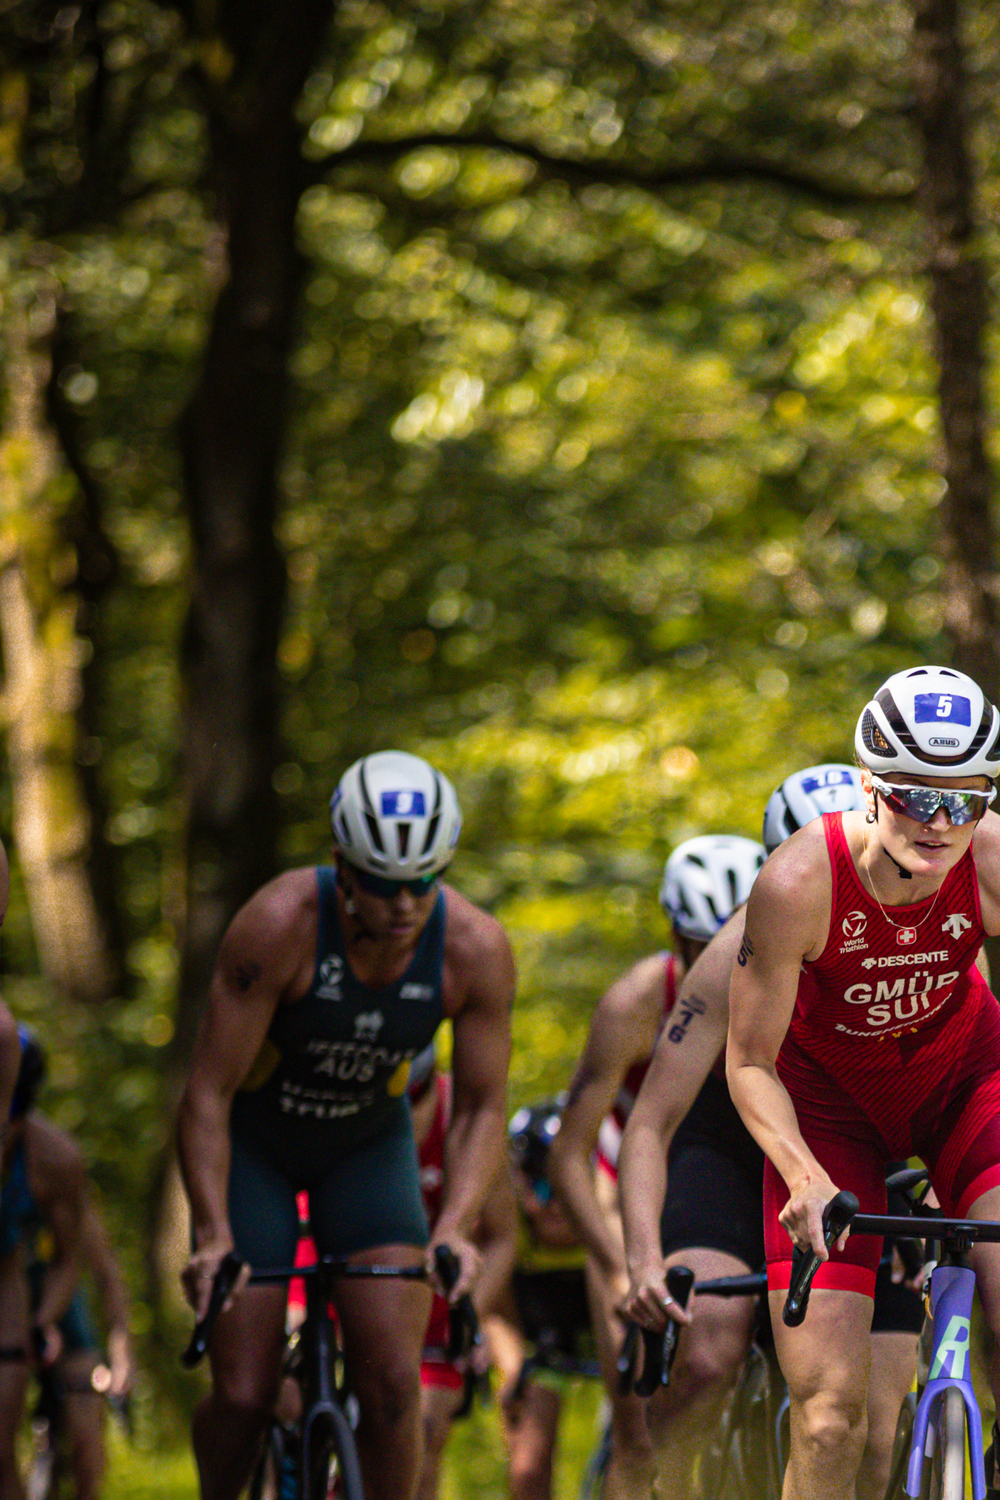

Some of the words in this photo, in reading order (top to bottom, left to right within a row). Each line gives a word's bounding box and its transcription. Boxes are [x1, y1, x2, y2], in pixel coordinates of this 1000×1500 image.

[936, 695, 953, 717] 5
[839, 943, 869, 954] Triathlon
[843, 937, 865, 947] World
[877, 950, 949, 968] DESCENTE
[866, 991, 931, 1027] SUI
